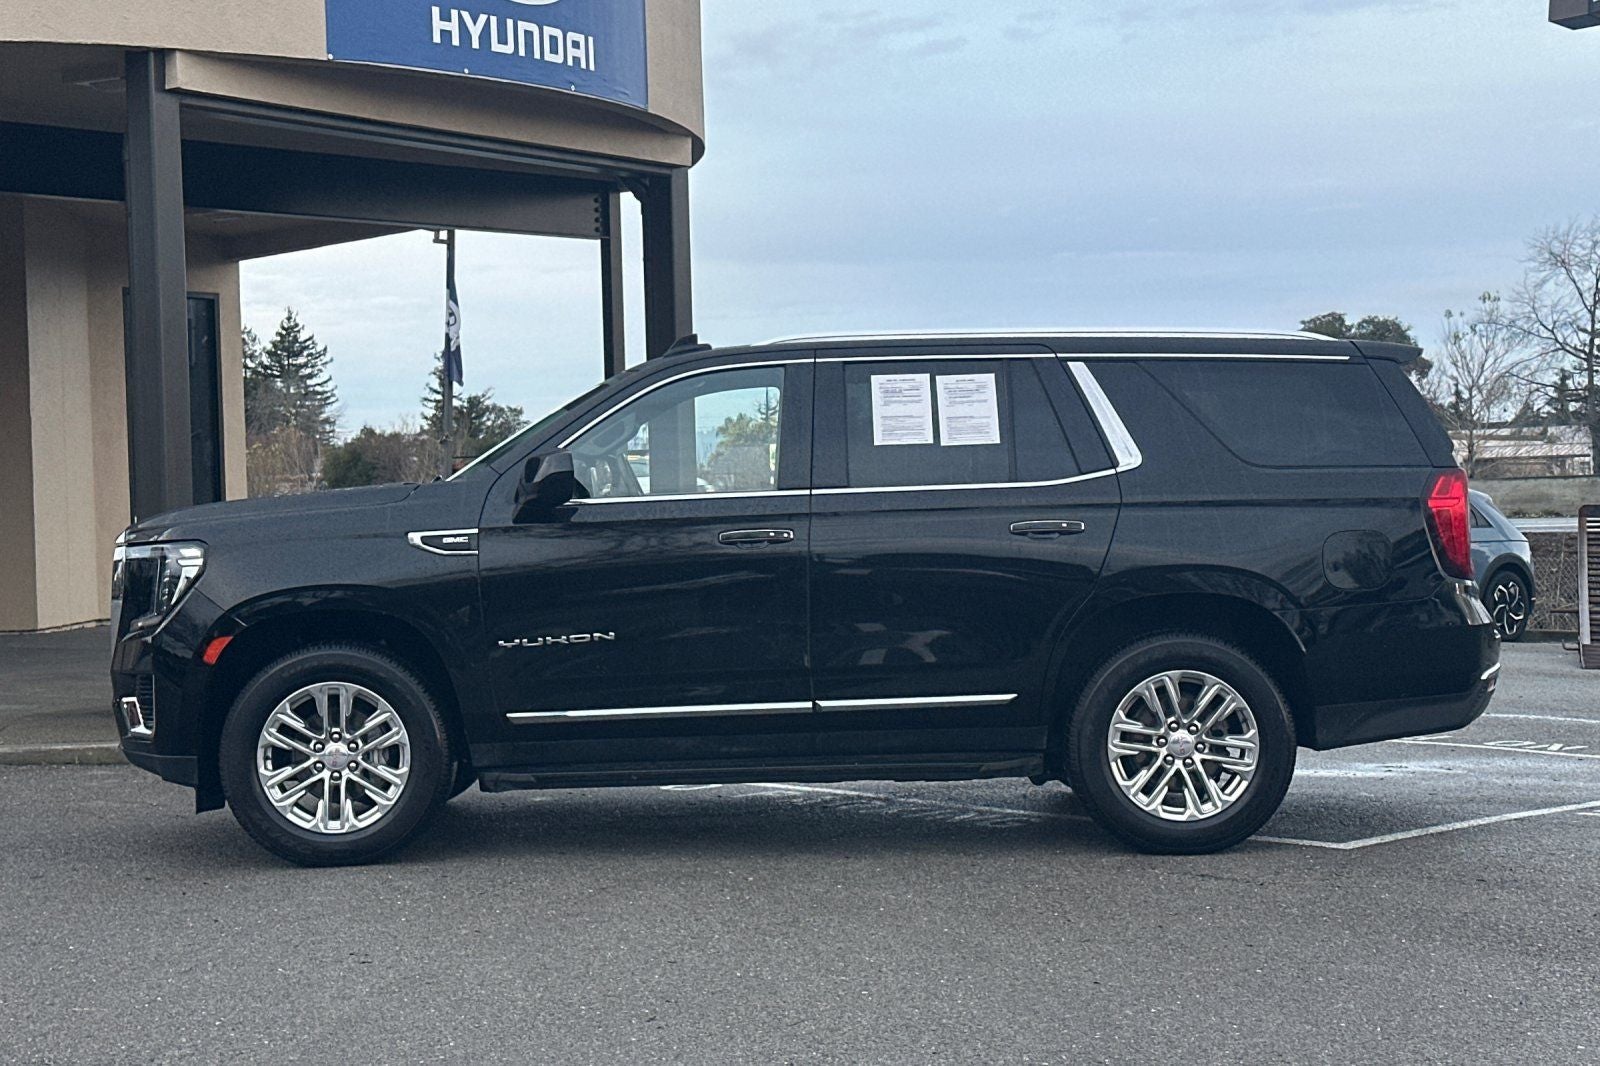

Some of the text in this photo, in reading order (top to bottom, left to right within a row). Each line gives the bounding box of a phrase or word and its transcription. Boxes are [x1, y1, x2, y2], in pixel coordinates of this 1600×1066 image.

[431, 5, 596, 72] HYUNDAI
[442, 536, 469, 544] GMC
[498, 631, 615, 648] YUKON
